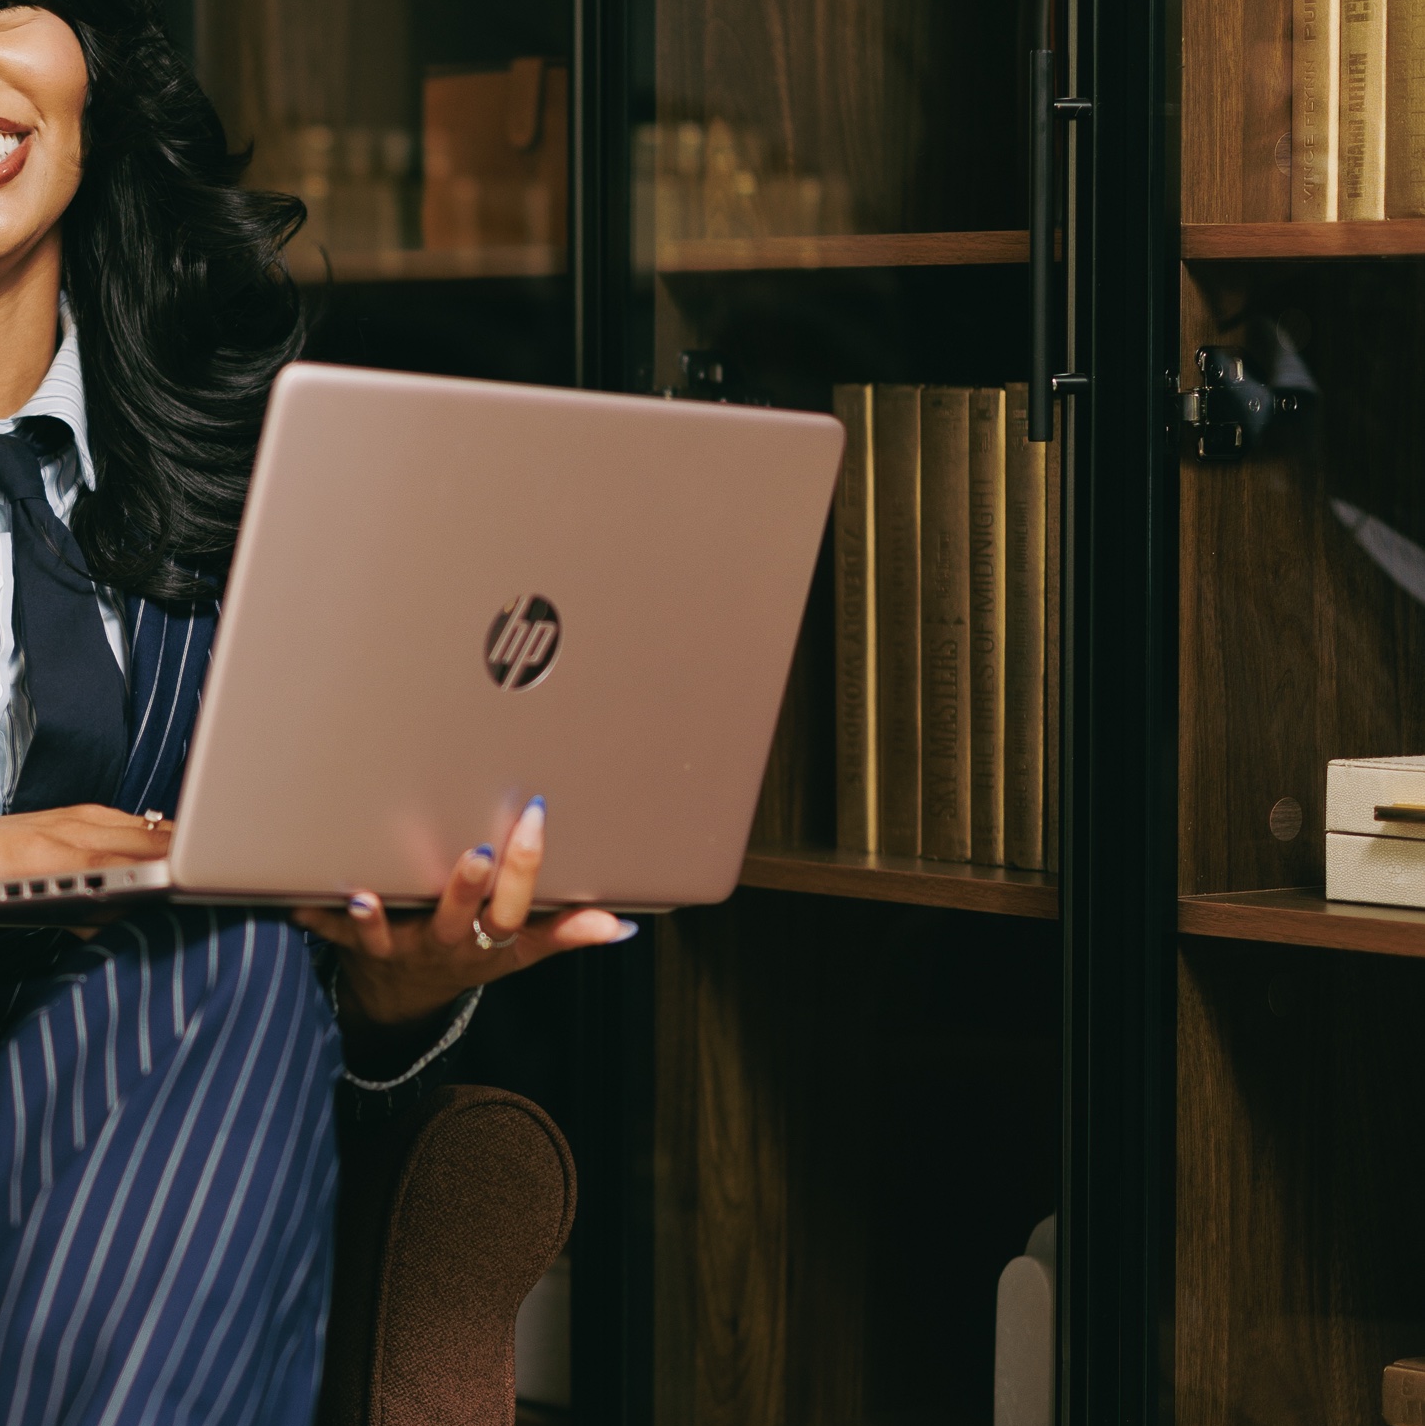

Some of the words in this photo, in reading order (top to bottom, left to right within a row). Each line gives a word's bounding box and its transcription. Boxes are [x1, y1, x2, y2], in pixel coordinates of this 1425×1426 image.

[1302, 60, 1316, 128] FLYNN
[1302, 133, 1316, 204] VINCE
[1346, 119, 1365, 199] RICHARD
[972, 478, 995, 614] MIDNIGHT
[842, 556, 864, 645] DEADLY
[973, 622, 995, 654] OF
[488, 593, 559, 692] hp
[842, 655, 863, 785] WONDERS
[928, 639, 958, 759] MASTERS
[974, 664, 995, 735] FIRES
[928, 771, 958, 820] SKY
[974, 746, 995, 790] THE
